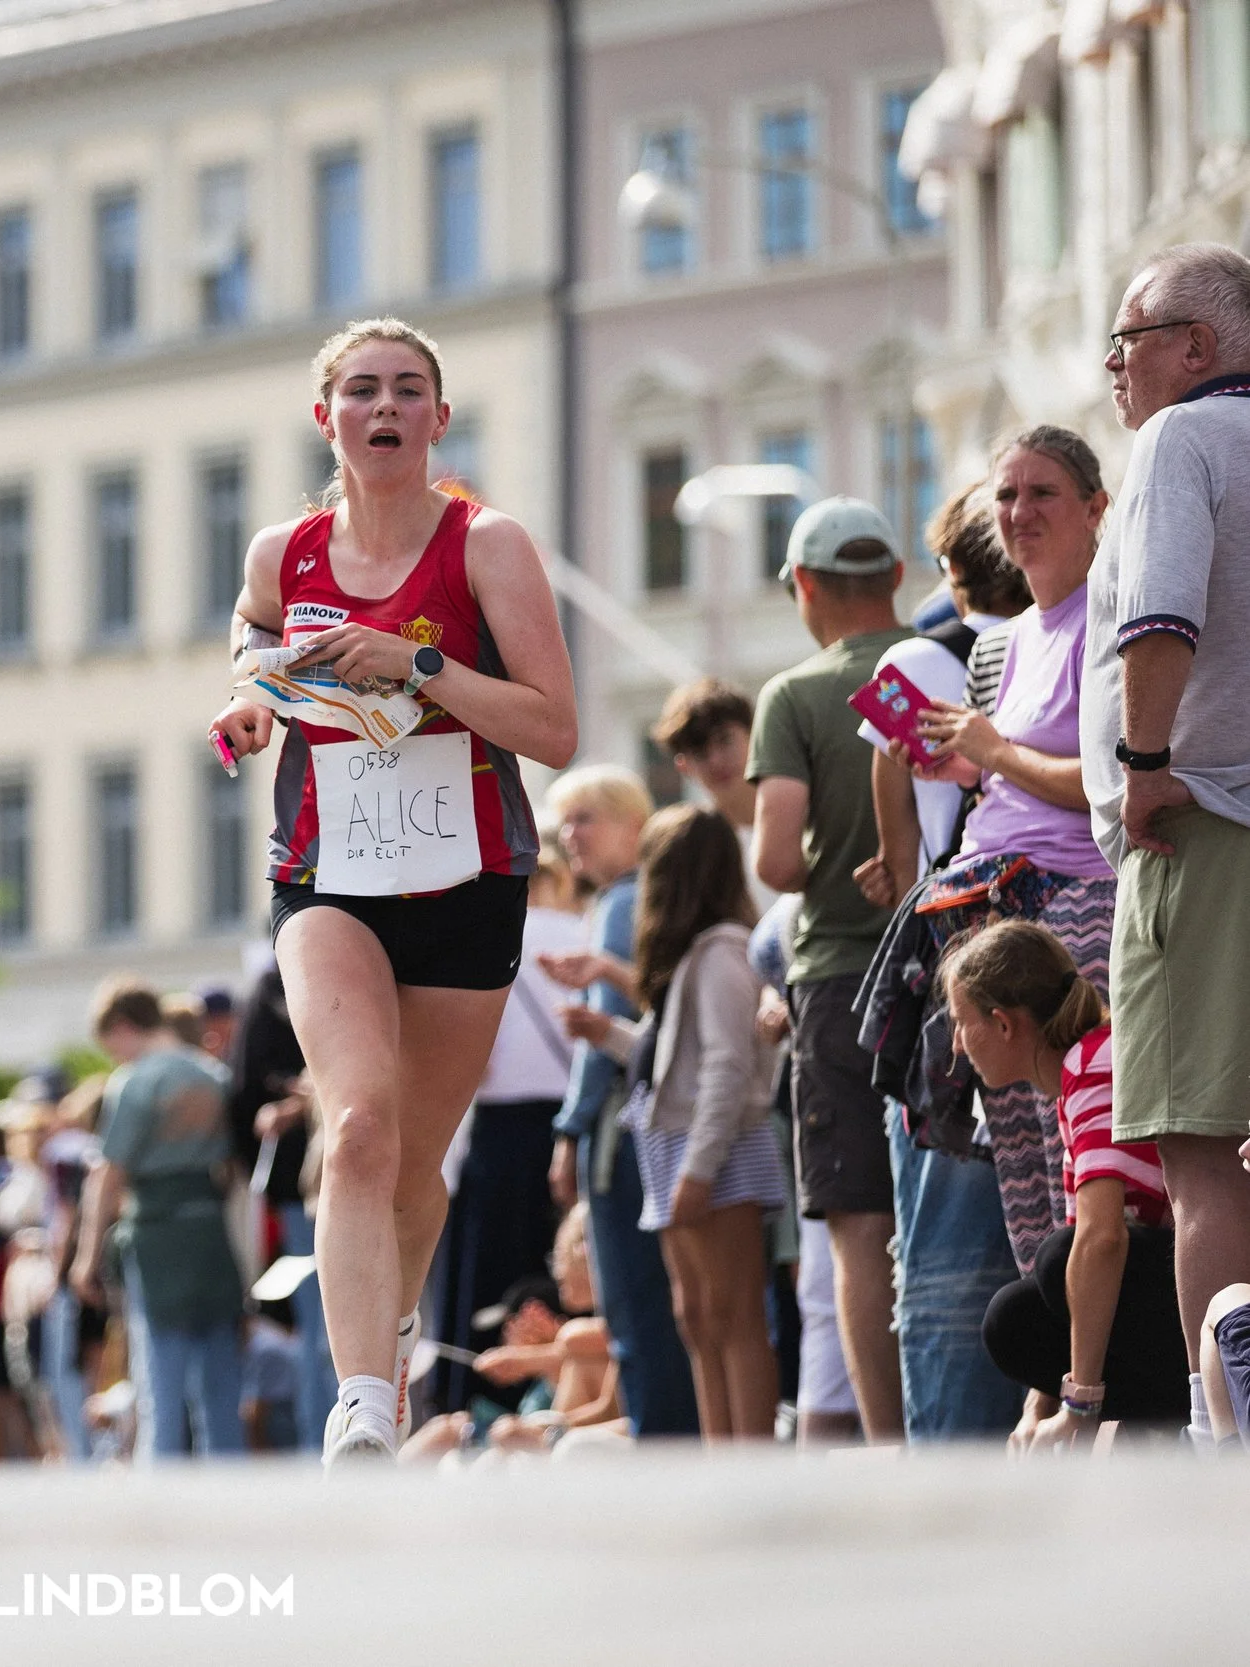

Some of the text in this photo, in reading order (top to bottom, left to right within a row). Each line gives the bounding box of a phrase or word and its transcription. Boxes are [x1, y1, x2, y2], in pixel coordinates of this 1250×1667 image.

[293, 606, 344, 620] VIANOVA
[348, 750, 401, 781] 0558
[347, 785, 457, 844] ALICE
[374, 845, 412, 860] ELIT
[396, 1355, 408, 1428] TERREX
